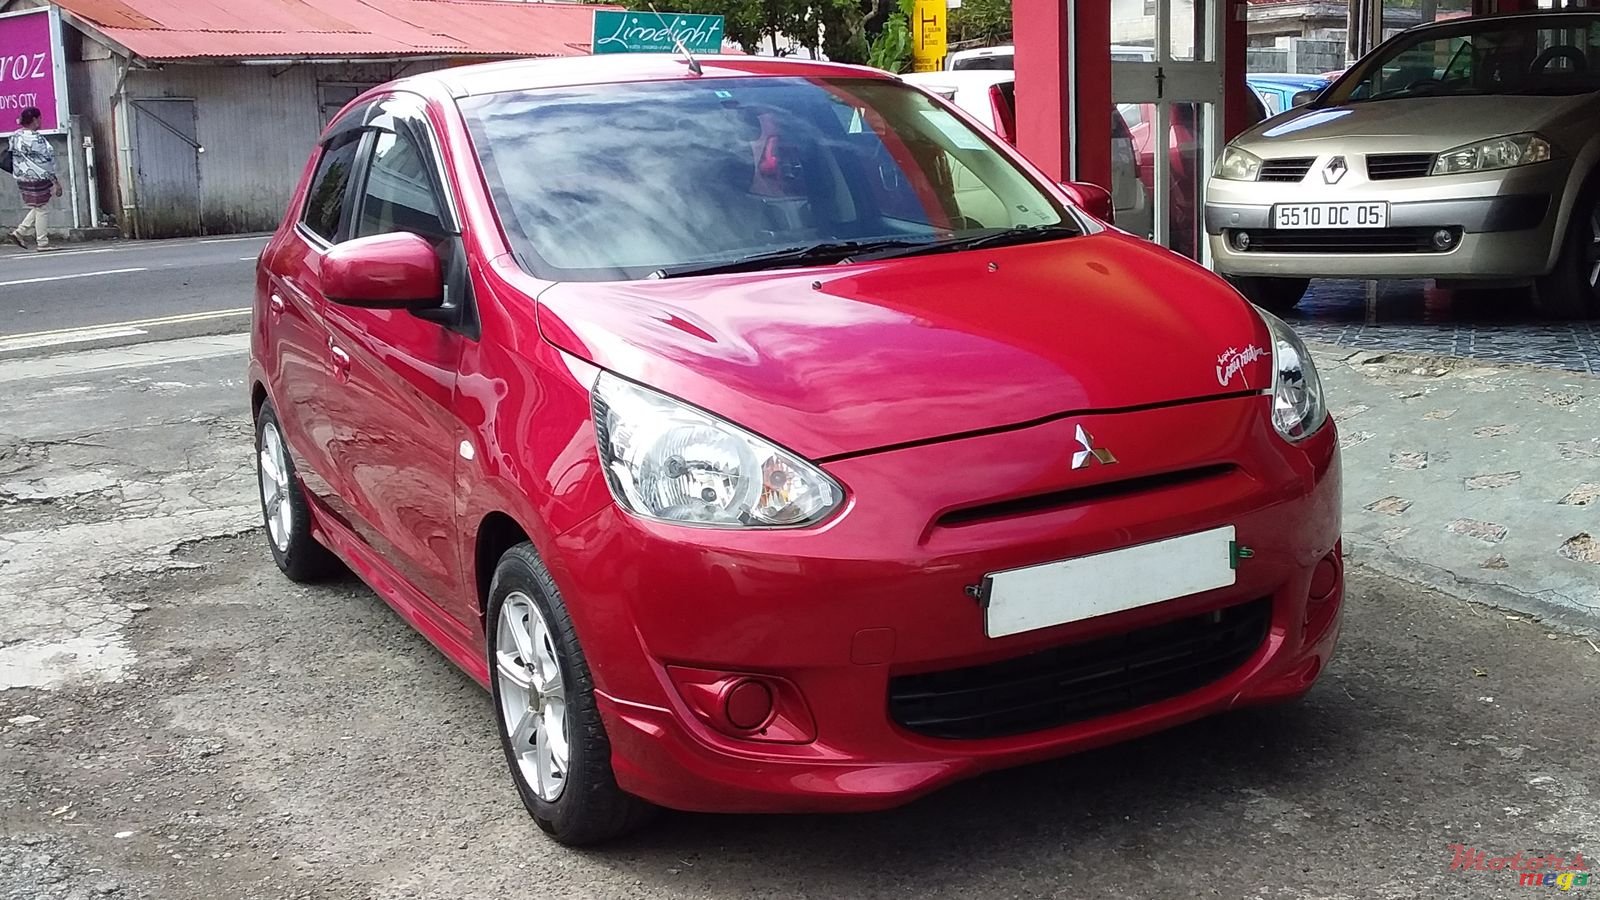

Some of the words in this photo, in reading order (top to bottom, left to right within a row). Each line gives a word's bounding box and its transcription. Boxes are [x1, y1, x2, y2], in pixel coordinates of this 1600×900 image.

[598, 14, 721, 53] Limelight
[19, 93, 37, 108] CITY
[1281, 207, 1320, 225] 5510
[1328, 206, 1349, 225] DC
[1358, 206, 1379, 224] 05
